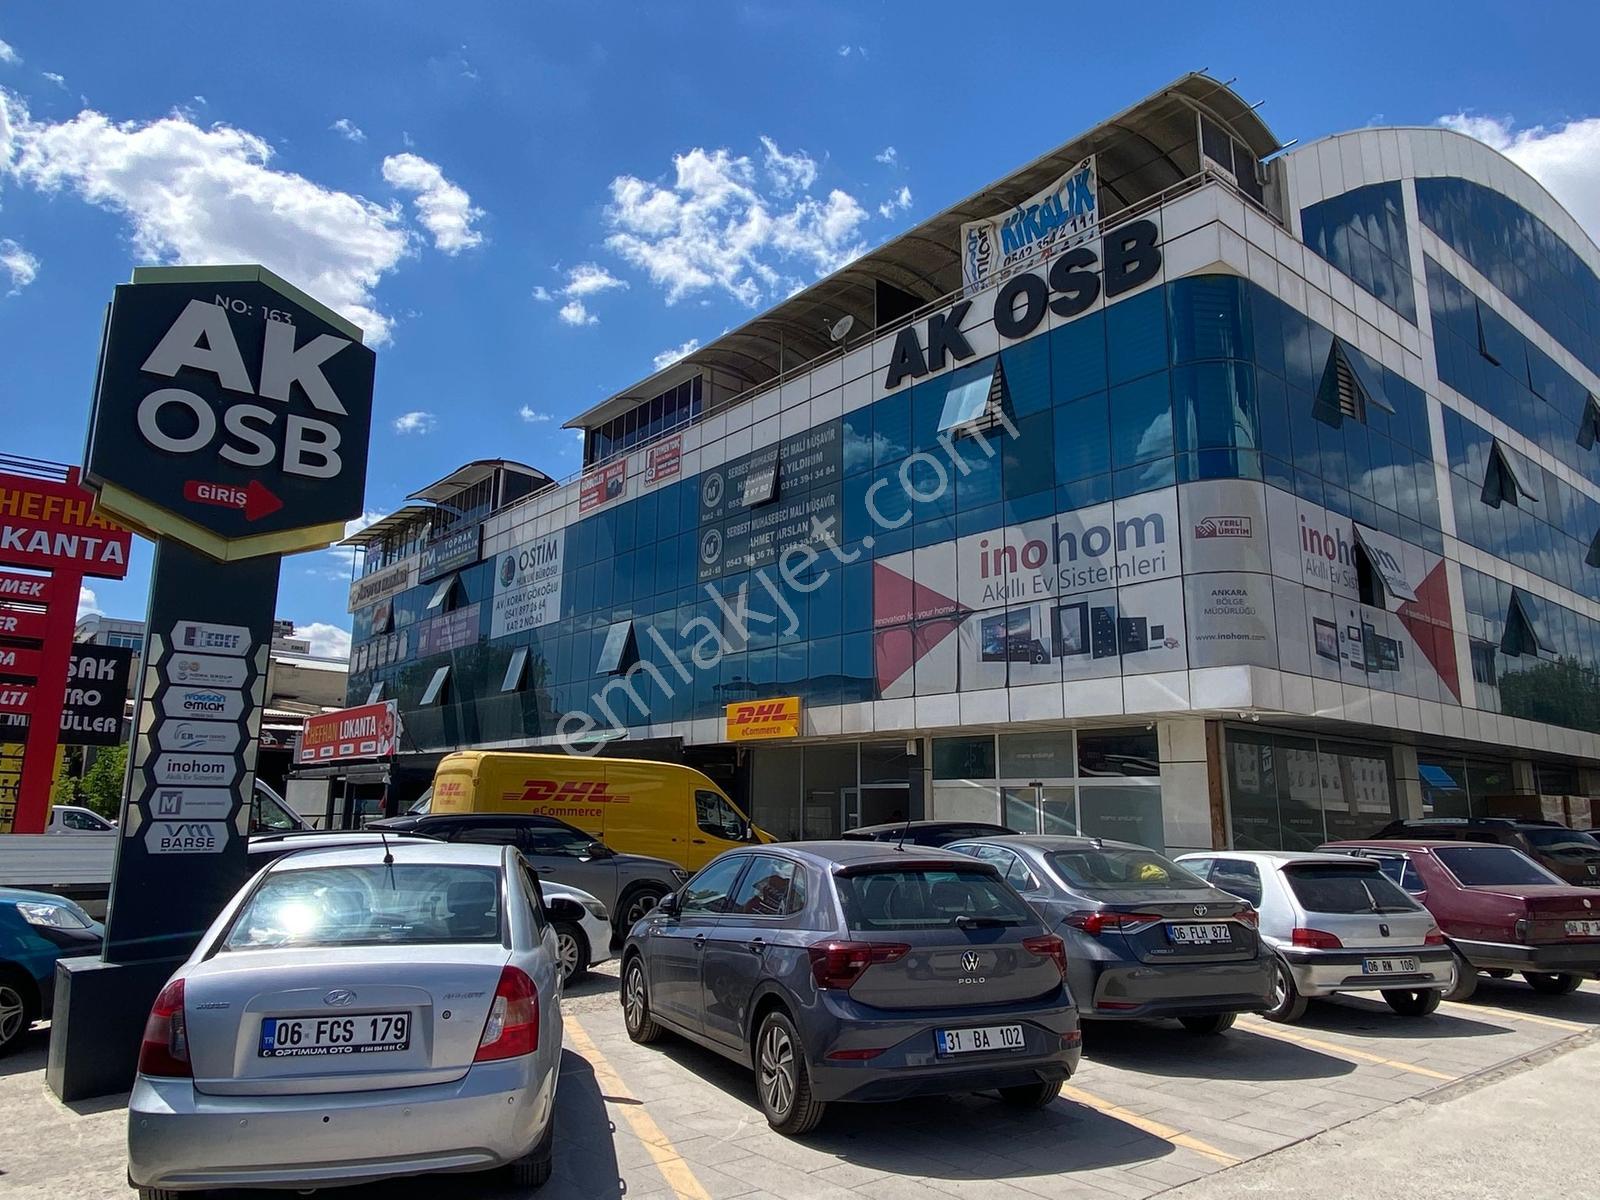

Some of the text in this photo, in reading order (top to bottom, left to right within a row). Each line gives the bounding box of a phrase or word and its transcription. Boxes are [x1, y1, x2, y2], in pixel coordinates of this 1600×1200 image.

[215, 294, 253, 314] NO:
[885, 300, 976, 390] AK
[994, 219, 1162, 340] OSB
[140, 299, 353, 416] AK
[137, 388, 343, 479] OSB
[197, 484, 248, 508] GİRİŞ
[444, 530, 472, 550] TOPRAK
[980, 513, 1165, 579] inohom
[519, 538, 558, 571] OSTİM
[982, 550, 1166, 603] Akıllı Ev Sistemleri
[735, 703, 788, 724] DHL
[339, 715, 376, 740] LOKANTA
[741, 726, 782, 737] eCommerce
[167, 758, 225, 773] inohom
[520, 779, 614, 803] DHL
[533, 805, 602, 817] eCommerce
[160, 837, 215, 848] BARSE
[1173, 926, 1230, 940] 06 FLH 872
[1368, 961, 1379, 972] 06
[277, 1017, 406, 1046] 06 FCS 179
[946, 1027, 1022, 1051] 31 BA 102
[329, 1046, 352, 1054] OTO
